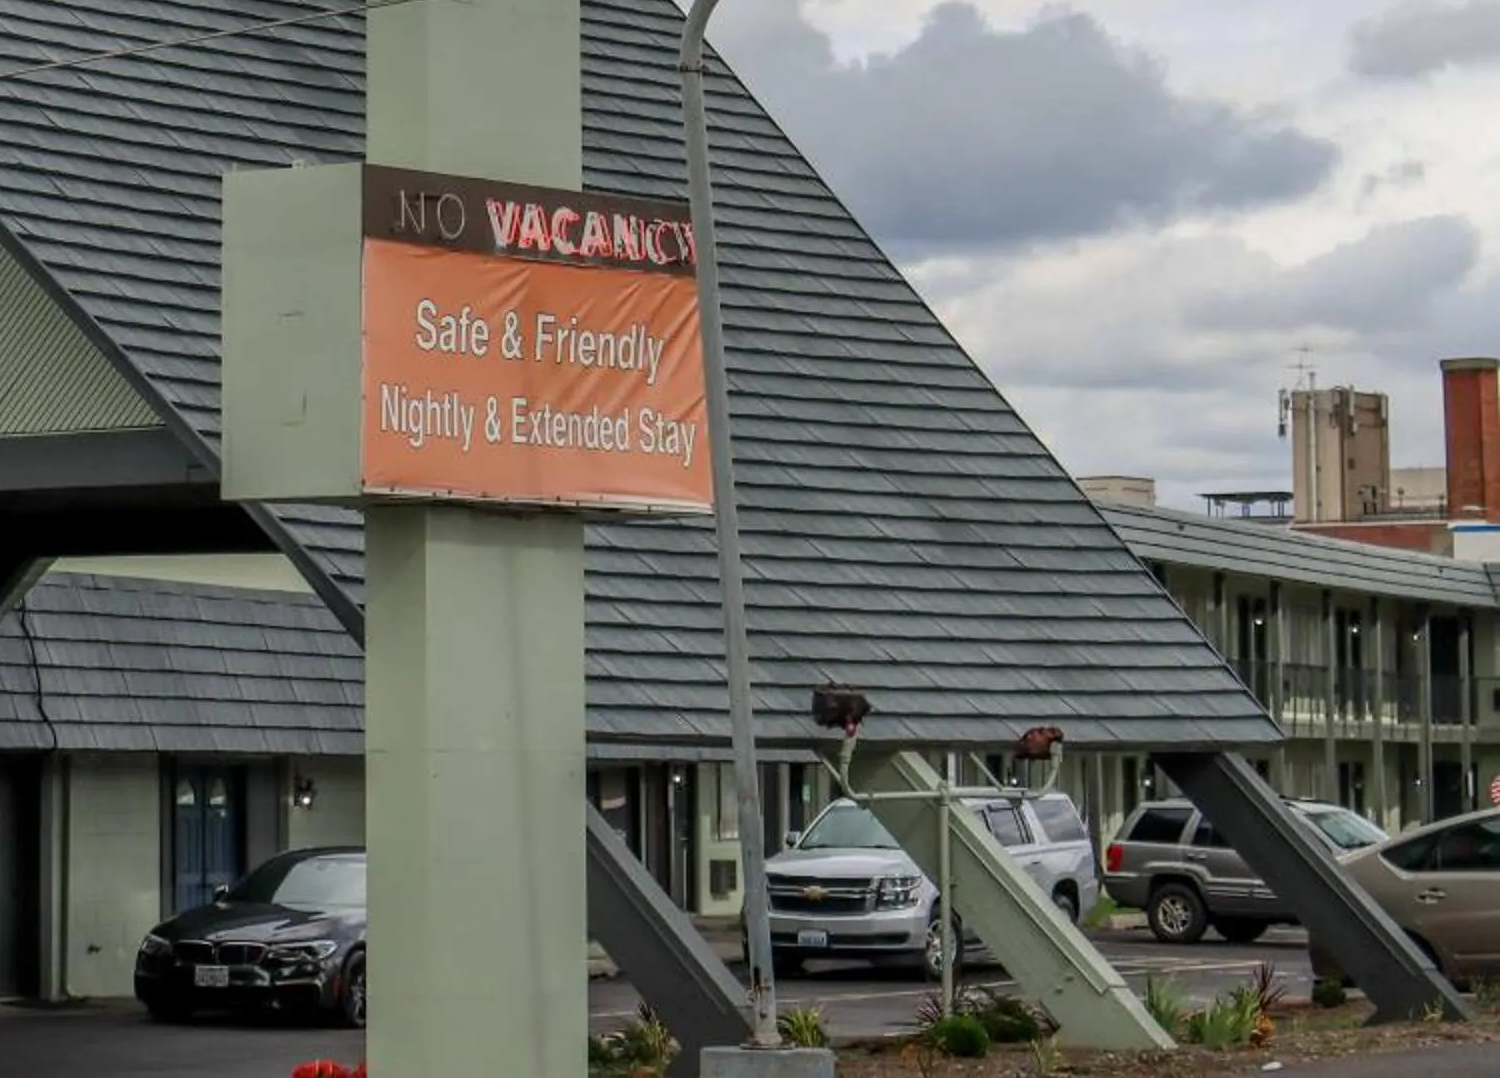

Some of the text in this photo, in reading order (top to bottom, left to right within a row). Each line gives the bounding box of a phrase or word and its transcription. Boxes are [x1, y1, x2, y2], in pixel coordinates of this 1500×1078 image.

[399, 190, 466, 241] NO
[414, 298, 665, 386] Safe & Friendly
[380, 383, 697, 468] Nightly & Extended Stay
